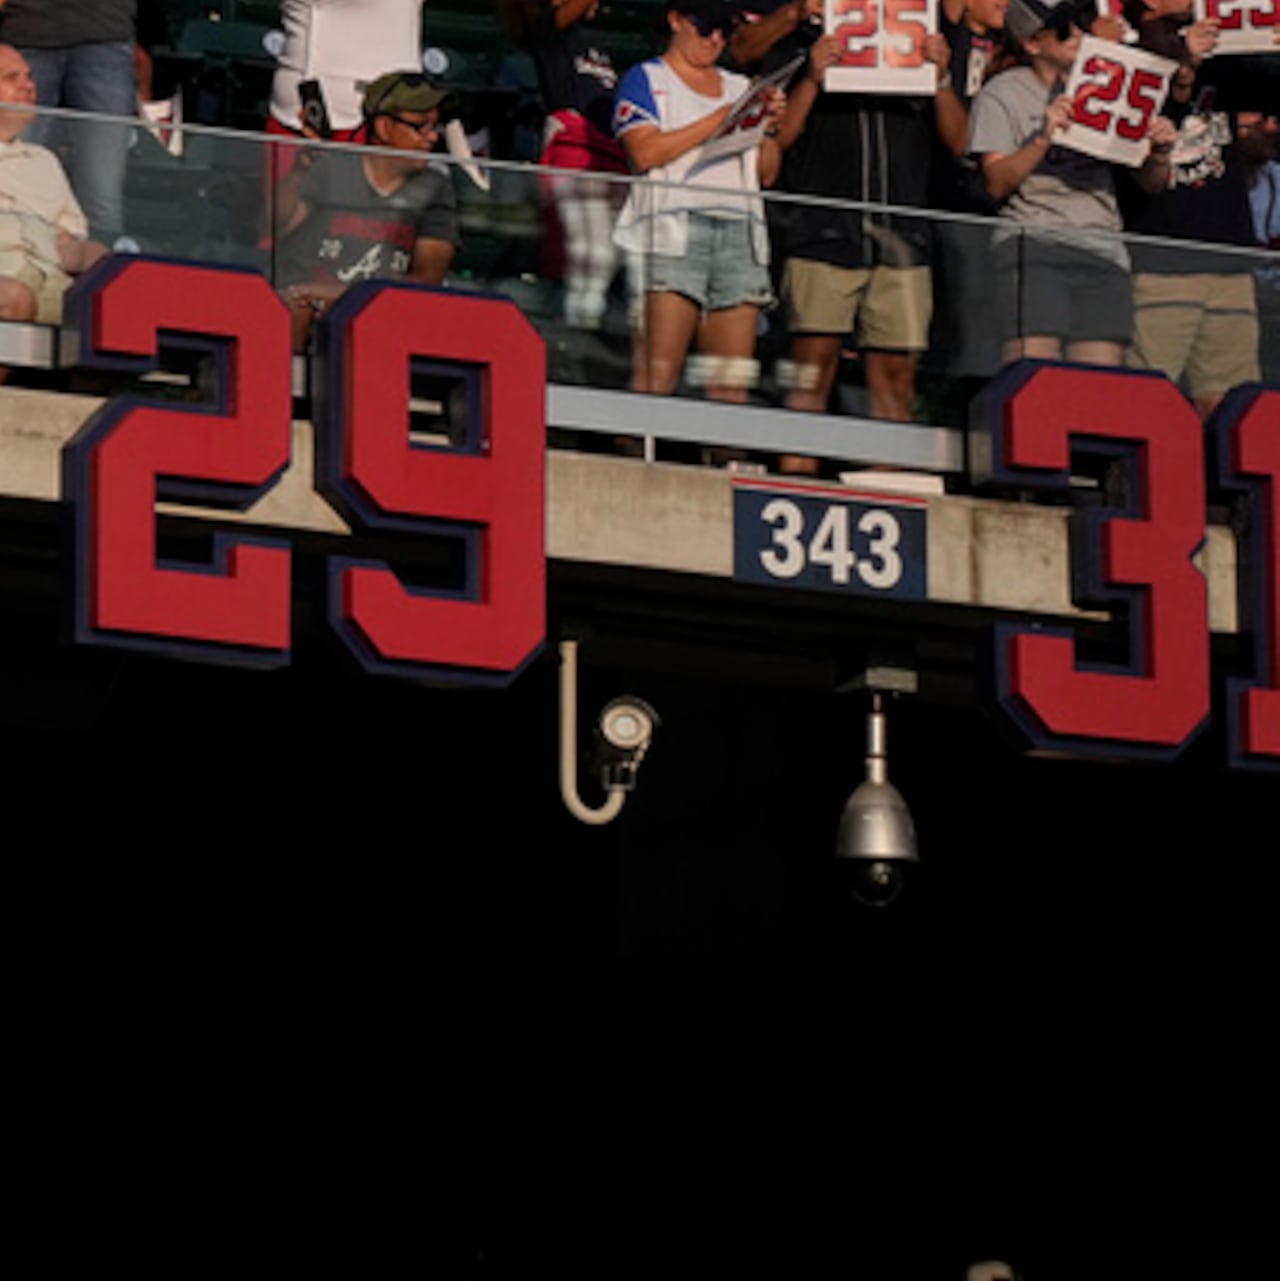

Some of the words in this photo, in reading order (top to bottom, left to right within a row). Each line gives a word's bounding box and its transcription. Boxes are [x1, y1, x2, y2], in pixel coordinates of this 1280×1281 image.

[1075, 58, 1162, 140] 25
[78, 255, 546, 682] 29
[759, 499, 903, 589] 343
